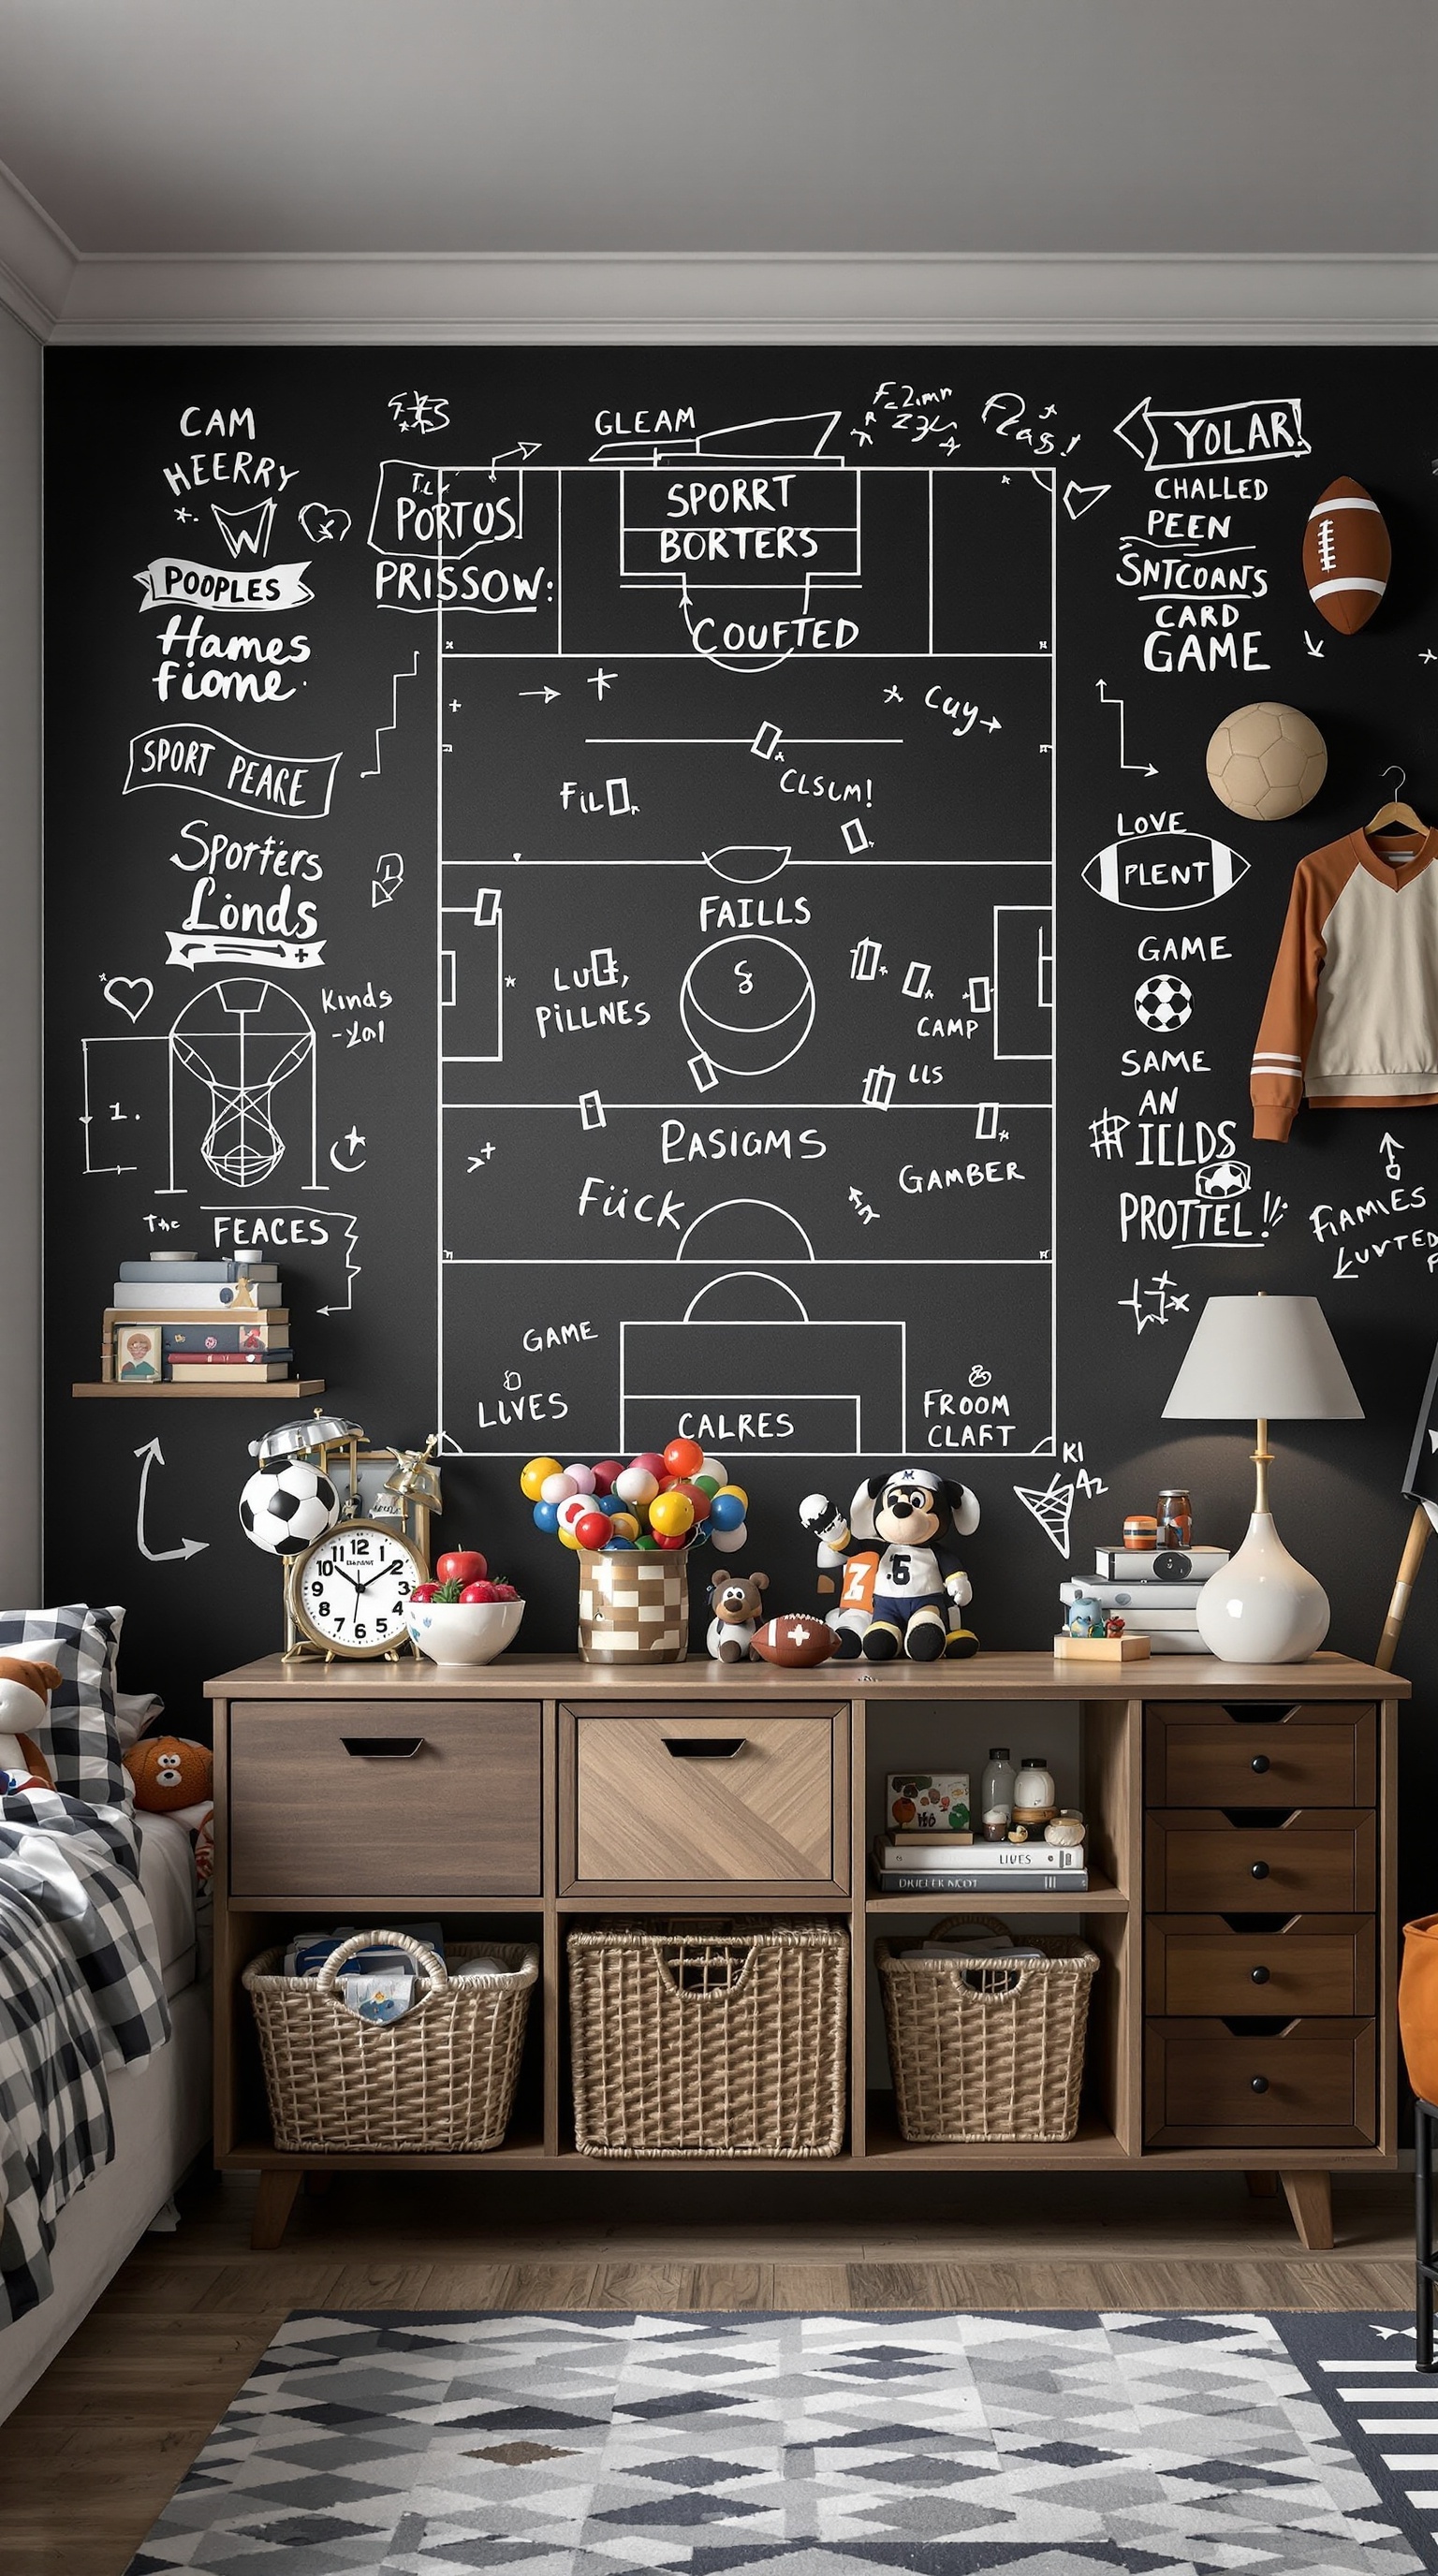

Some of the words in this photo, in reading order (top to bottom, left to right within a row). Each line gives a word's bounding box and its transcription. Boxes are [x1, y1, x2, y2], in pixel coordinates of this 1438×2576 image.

[180, 406, 256, 440] CAM
[594, 406, 696, 436] GLEAM
[163, 451, 300, 497] HEERRY
[1154, 476, 1269, 501] CHALLED
[667, 474, 797, 518] SPORRT
[397, 496, 516, 541] PORTUS
[1148, 509, 1232, 540] PEEN
[660, 526, 819, 564] BORTERS
[165, 565, 281, 603] POOPLES
[1155, 603, 1240, 629] CARD
[155, 614, 311, 665] Hames
[693, 617, 859, 652] COUFTED
[1143, 630, 1271, 673] GAME
[140, 738, 216, 777] SPORT
[1118, 812, 1187, 836] LOVE
[1124, 860, 1211, 886] PLENT
[699, 895, 812, 932] FAILLS
[1137, 935, 1233, 962] GAME
[321, 981, 393, 1014] Kinds
[917, 1016, 979, 1040] CAMP
[1121, 1049, 1211, 1076] SAME
[1138, 1086, 1179, 1117] AN
[898, 1161, 1026, 1194] GAMBER
[213, 1217, 330, 1247] FEACES
[522, 1321, 599, 1353] GAME
[923, 1388, 1010, 1418] FROOM
[678, 1412, 795, 1440] CALRES
[331, 1545, 345, 1562] 11
[350, 1539, 370, 1556] 12
[379, 1545, 385, 1562] 1
[316, 1559, 333, 1576] 10
[312, 1581, 324, 1597] 9
[398, 1581, 411, 1596] 3
[318, 1602, 330, 1617] 8
[392, 1601, 404, 1616] 4
[334, 1617, 345, 1632] 7
[354, 1623, 366, 1639] 6
[375, 1617, 388, 1632] 5
